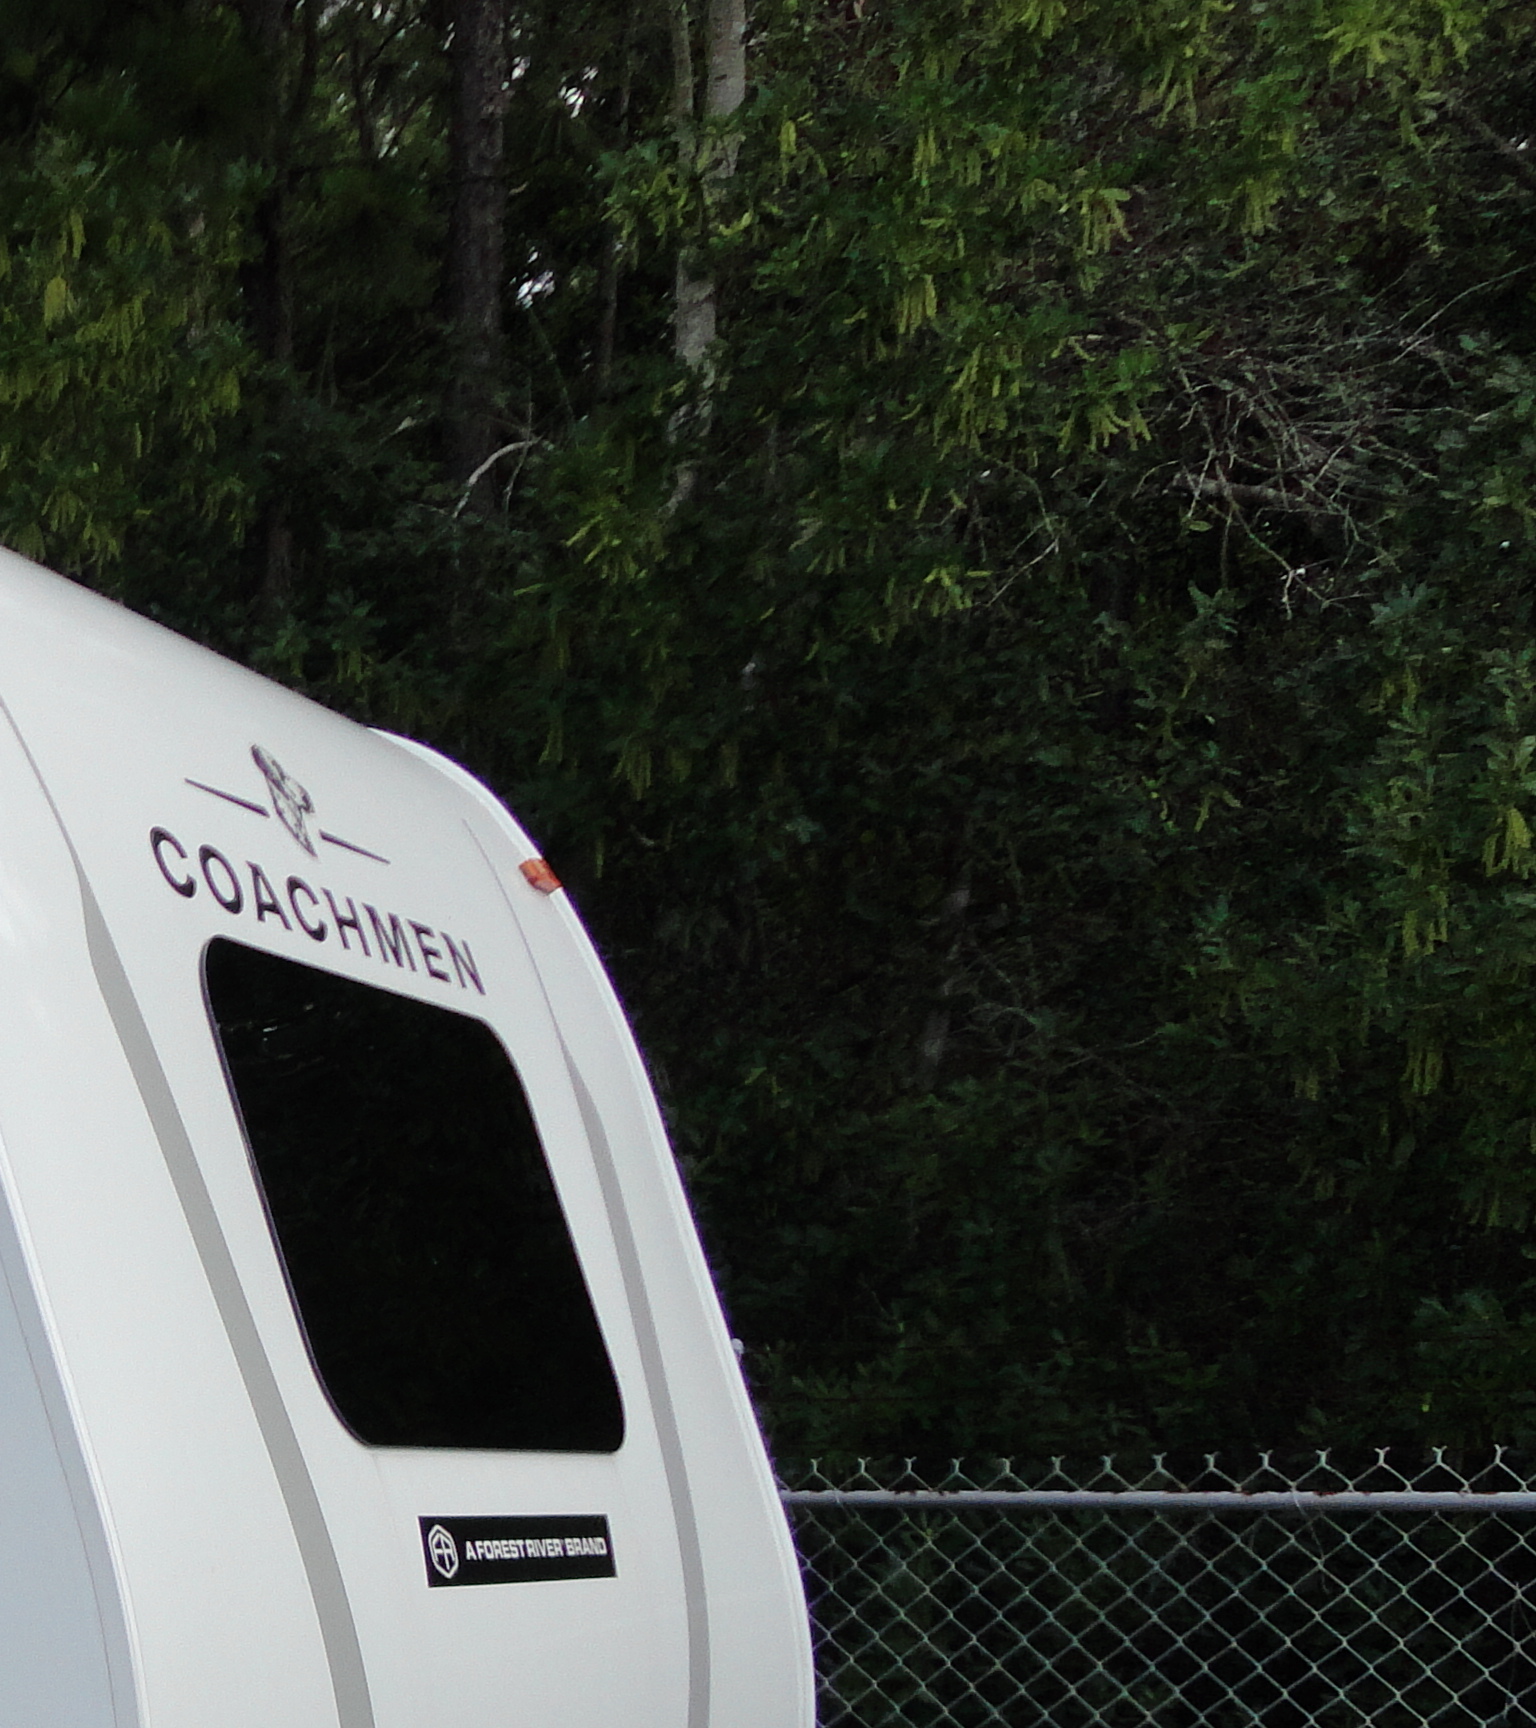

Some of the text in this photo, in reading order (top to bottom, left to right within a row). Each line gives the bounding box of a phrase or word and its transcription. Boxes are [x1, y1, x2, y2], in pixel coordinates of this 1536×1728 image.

[149, 826, 486, 996] COACHMEN
[466, 1541, 477, 1561] A
[475, 1539, 526, 1561] FOREST
[525, 1538, 565, 1559] RIVER
[564, 1537, 608, 1557] BRAND
